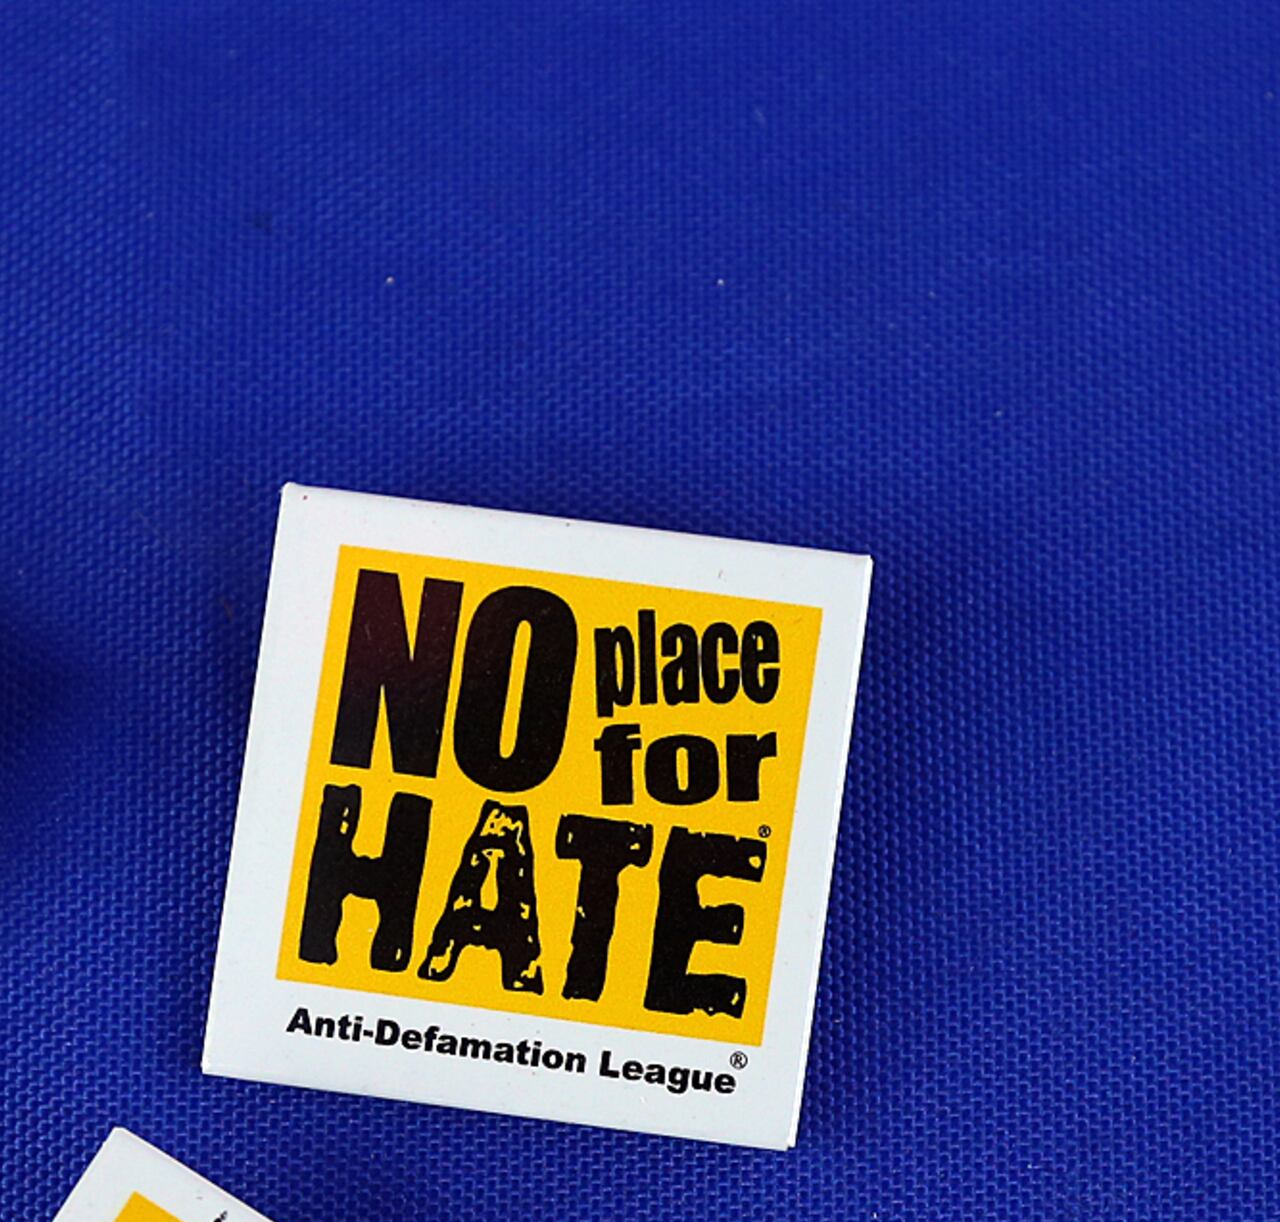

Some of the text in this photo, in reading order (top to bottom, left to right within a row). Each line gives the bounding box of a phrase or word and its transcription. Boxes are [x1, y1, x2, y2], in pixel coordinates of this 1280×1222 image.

[329, 568, 780, 793] NO place
[593, 723, 777, 805] for
[286, 1007, 587, 1074] Anti-Defamation
